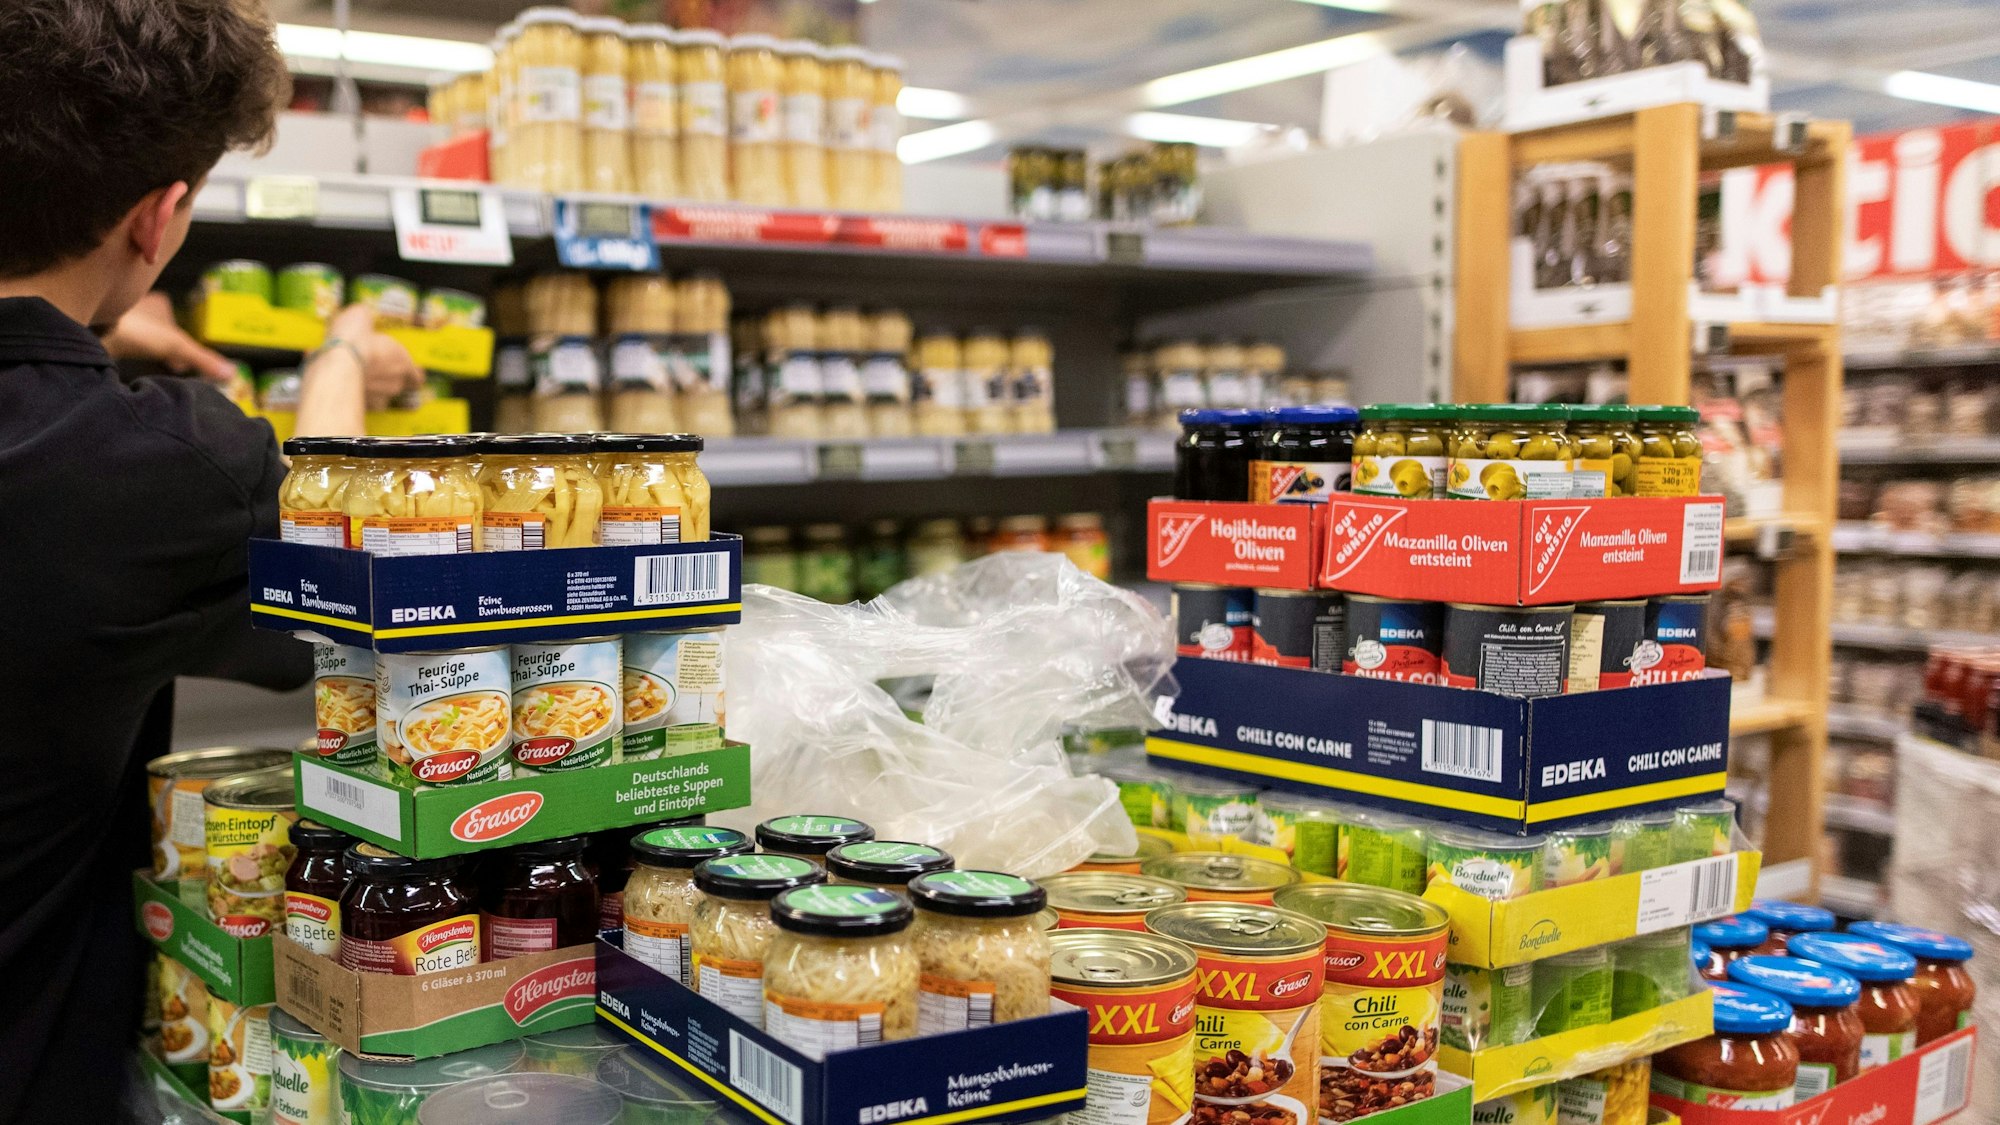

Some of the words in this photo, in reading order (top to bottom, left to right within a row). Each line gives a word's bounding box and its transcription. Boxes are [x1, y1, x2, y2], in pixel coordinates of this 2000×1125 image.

[1210, 517, 1297, 544] Hojiblanca
[1334, 509, 1358, 536] GUT
[1346, 526, 1358, 539] &
[1534, 514, 1553, 544] GUT
[1336, 513, 1384, 564] GÜNSTIG
[1383, 531, 1458, 551] Mazanilla
[1461, 534, 1508, 552] Oliven
[1536, 515, 1573, 574] GÜNSTIG
[1544, 532, 1554, 546] &
[1580, 528, 1636, 548] Manzanilla
[1638, 528, 1668, 545] Oliven
[1234, 538, 1285, 561] Oliven
[1602, 548, 1644, 564] entsteint
[1409, 552, 1472, 568] entsteint
[263, 587, 293, 604] EDEKA
[300, 579, 318, 594] Feine
[301, 594, 357, 615] Bambussprossen
[478, 595, 502, 606] Feine
[637, 596, 642, 604] 4
[648, 593, 681, 603] 311501
[685, 590, 716, 601] 351611
[391, 605, 456, 623] EDEKA
[478, 604, 553, 616] Bambussprossen
[1380, 627, 1425, 639] EDEKA
[1498, 623, 1517, 633] Chili
[1657, 627, 1697, 638] EDEKA
[518, 651, 561, 666] Feurige
[418, 660, 466, 679] Feurige
[511, 662, 575, 683] Thai-Suppe
[407, 671, 480, 697] Thai-Suppe
[518, 741, 570, 761] Erasco
[1236, 725, 1273, 746] CHILI
[1275, 731, 1304, 751] CON
[1306, 737, 1352, 759] CARNE
[337, 749, 361, 760] Natürlich
[560, 753, 589, 767] Natürlich
[589, 747, 605, 759] lecker
[419, 754, 476, 779] Erasco
[466, 764, 493, 781] Natürlich
[632, 762, 709, 785] Deutschlands
[1541, 757, 1606, 788] EDEKA
[1628, 751, 1660, 773] CHILI
[1661, 748, 1686, 768] CON
[1687, 742, 1722, 764] CARNE
[615, 784, 681, 803] beliebteste
[683, 777, 724, 796] Suppen
[633, 801, 656, 816] und
[658, 794, 706, 813] Eintöpfe
[463, 799, 536, 839] Erasco
[304, 924, 336, 941] Bete
[421, 924, 474, 947] Hengstenberg
[1519, 927, 1562, 951] Bonduelle
[415, 953, 451, 973] Rote
[456, 945, 478, 965] Bete
[1367, 950, 1427, 979] XXL
[421, 981, 428, 992] 6
[431, 976, 464, 991] Gläser
[466, 973, 473, 983] à
[1195, 967, 1261, 1001] XXL
[1274, 973, 1311, 996] Erasco
[600, 989, 631, 1020] EDEKA
[1353, 995, 1397, 1014] Chili
[1090, 1002, 1161, 1035] XXL
[1344, 1021, 1369, 1031] con
[1372, 1016, 1410, 1028] Carne
[1200, 1037, 1241, 1050] Carne
[947, 1062, 1054, 1090] Mungobohnen-
[947, 1088, 992, 1108] Keime
[279, 1099, 308, 1119] Erbsen
[859, 1096, 929, 1125] EDEKA
